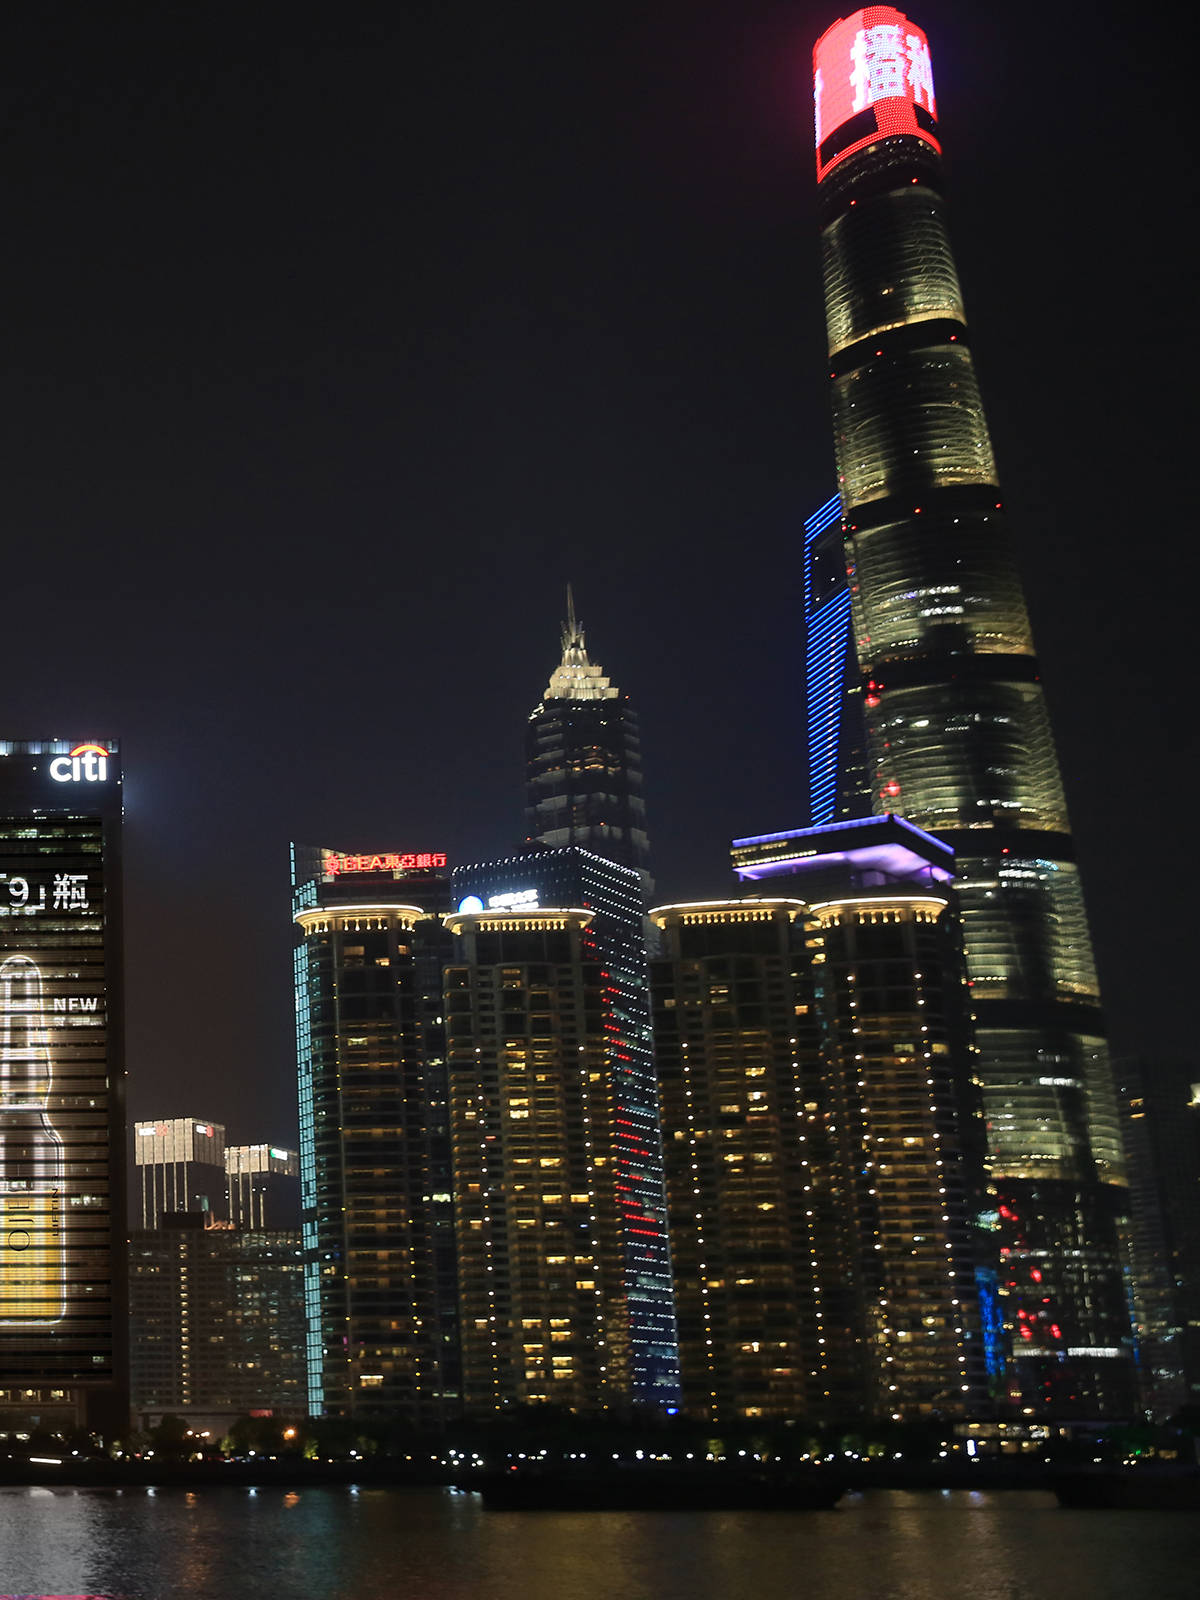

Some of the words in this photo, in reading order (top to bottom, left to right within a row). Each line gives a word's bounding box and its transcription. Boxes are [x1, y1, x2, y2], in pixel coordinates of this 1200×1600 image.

[50, 751, 107, 782] citi
[384, 853, 447, 870] 東亞銀行
[53, 997, 98, 1012] NEW
